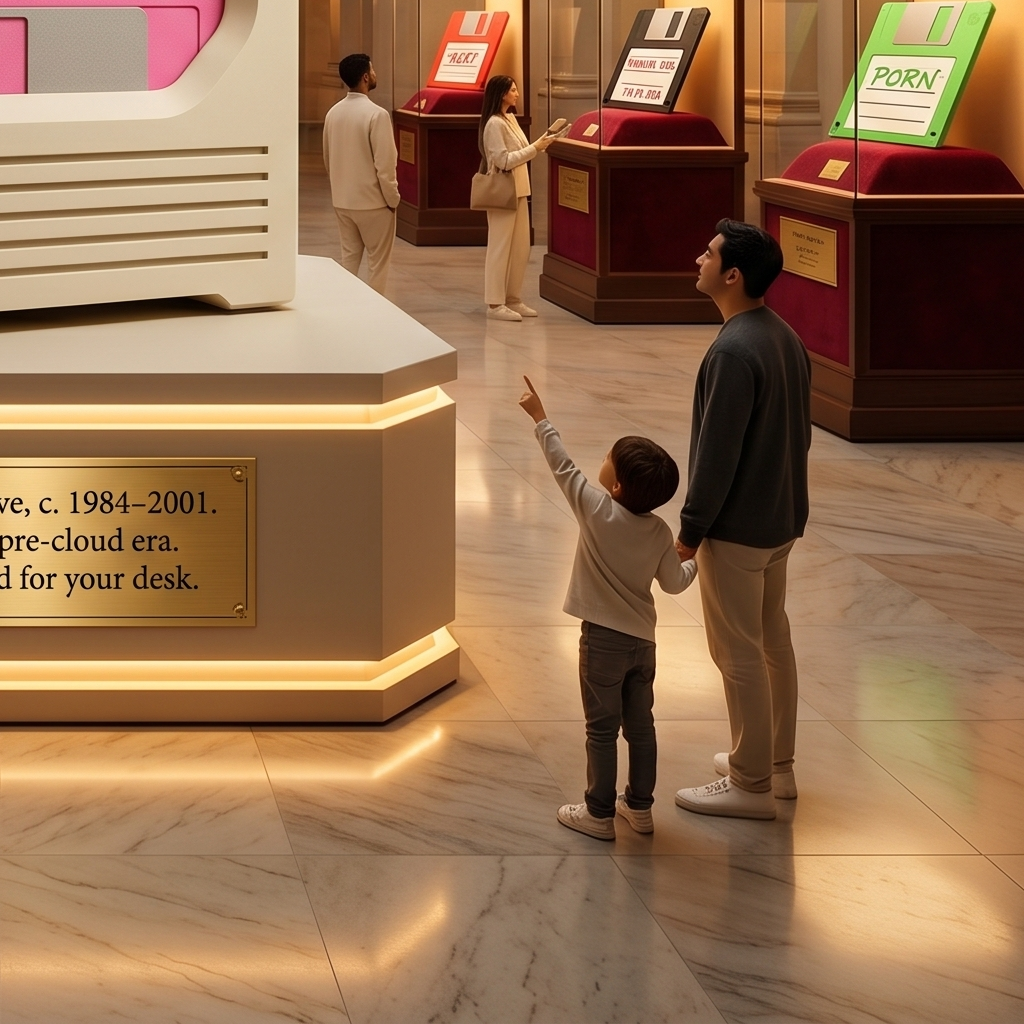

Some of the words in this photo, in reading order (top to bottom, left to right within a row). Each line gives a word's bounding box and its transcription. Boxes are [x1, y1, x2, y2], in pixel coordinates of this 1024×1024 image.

[870, 66, 942, 90] PORN
[38, 497, 59, 515] c.
[131, 534, 180, 553] era.
[19, 564, 59, 591] for
[63, 572, 125, 598] your
[132, 564, 200, 591] desk.
